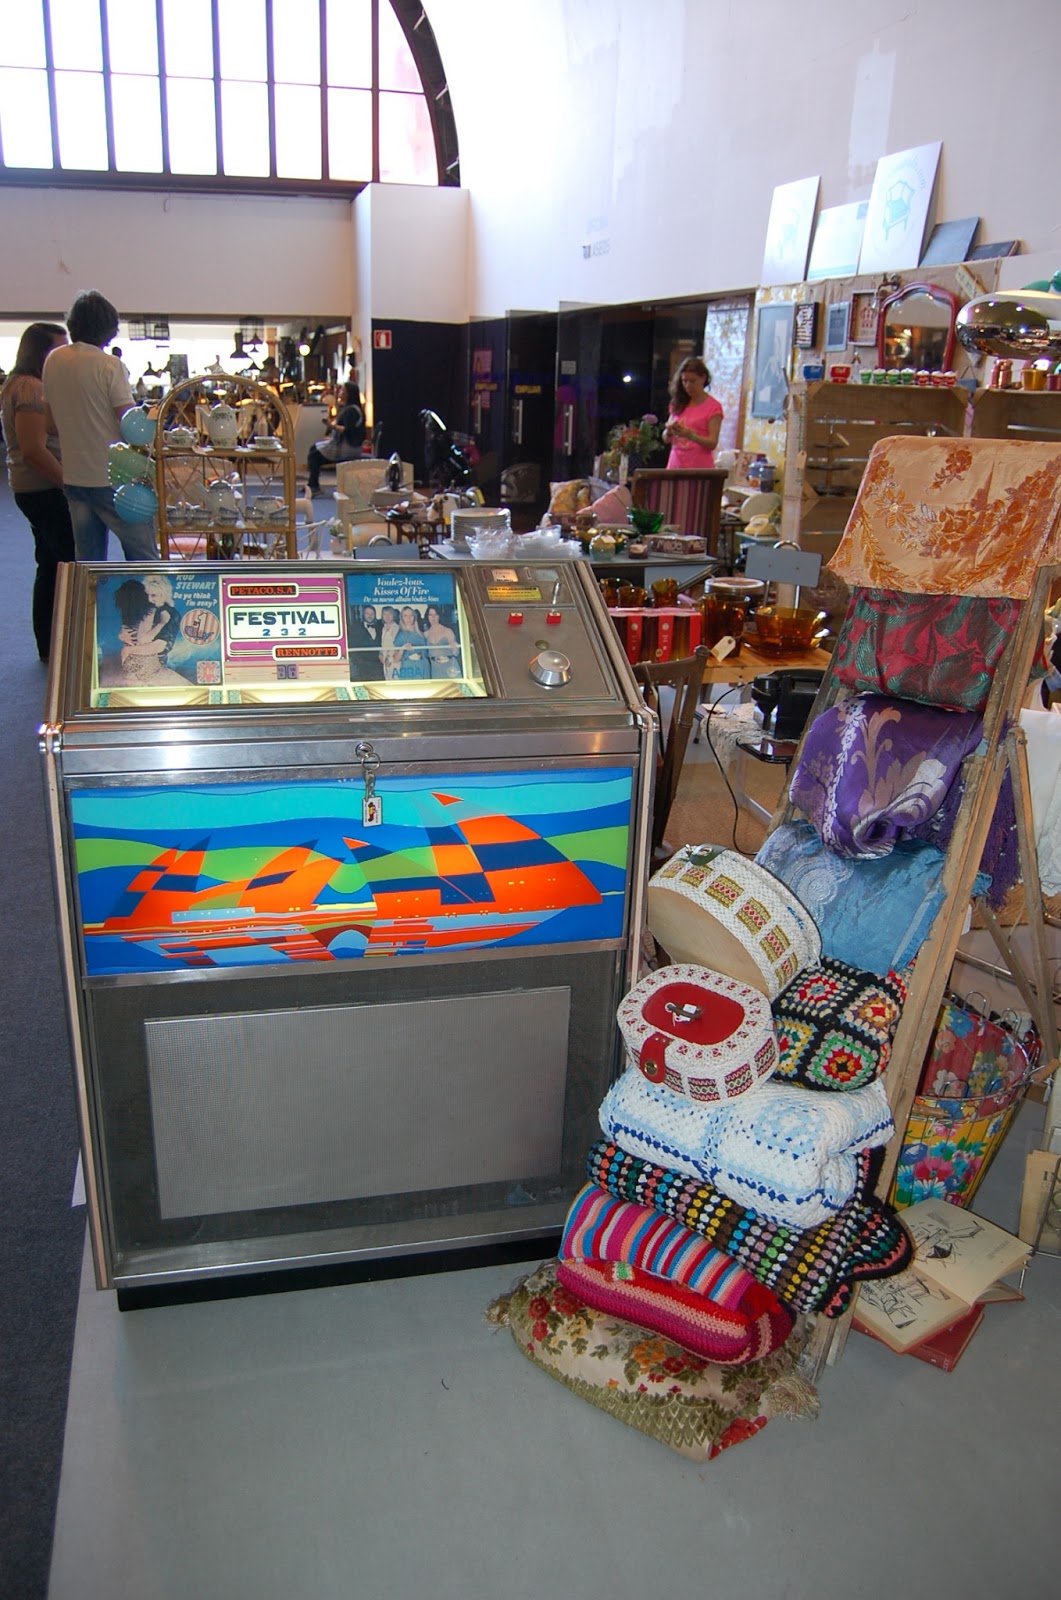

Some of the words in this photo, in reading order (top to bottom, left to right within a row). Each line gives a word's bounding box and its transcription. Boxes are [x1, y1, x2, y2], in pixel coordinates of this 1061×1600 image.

[175, 581, 217, 590] STEWART
[374, 587, 399, 596] Kisses
[399, 586, 412, 597] Of
[412, 587, 429, 595] Fire
[196, 599, 218, 608] sexy?
[233, 610, 335, 626] FESTIVAL
[276, 647, 338, 657] RENNOTTE
[392, 667, 422, 679] ABBA
